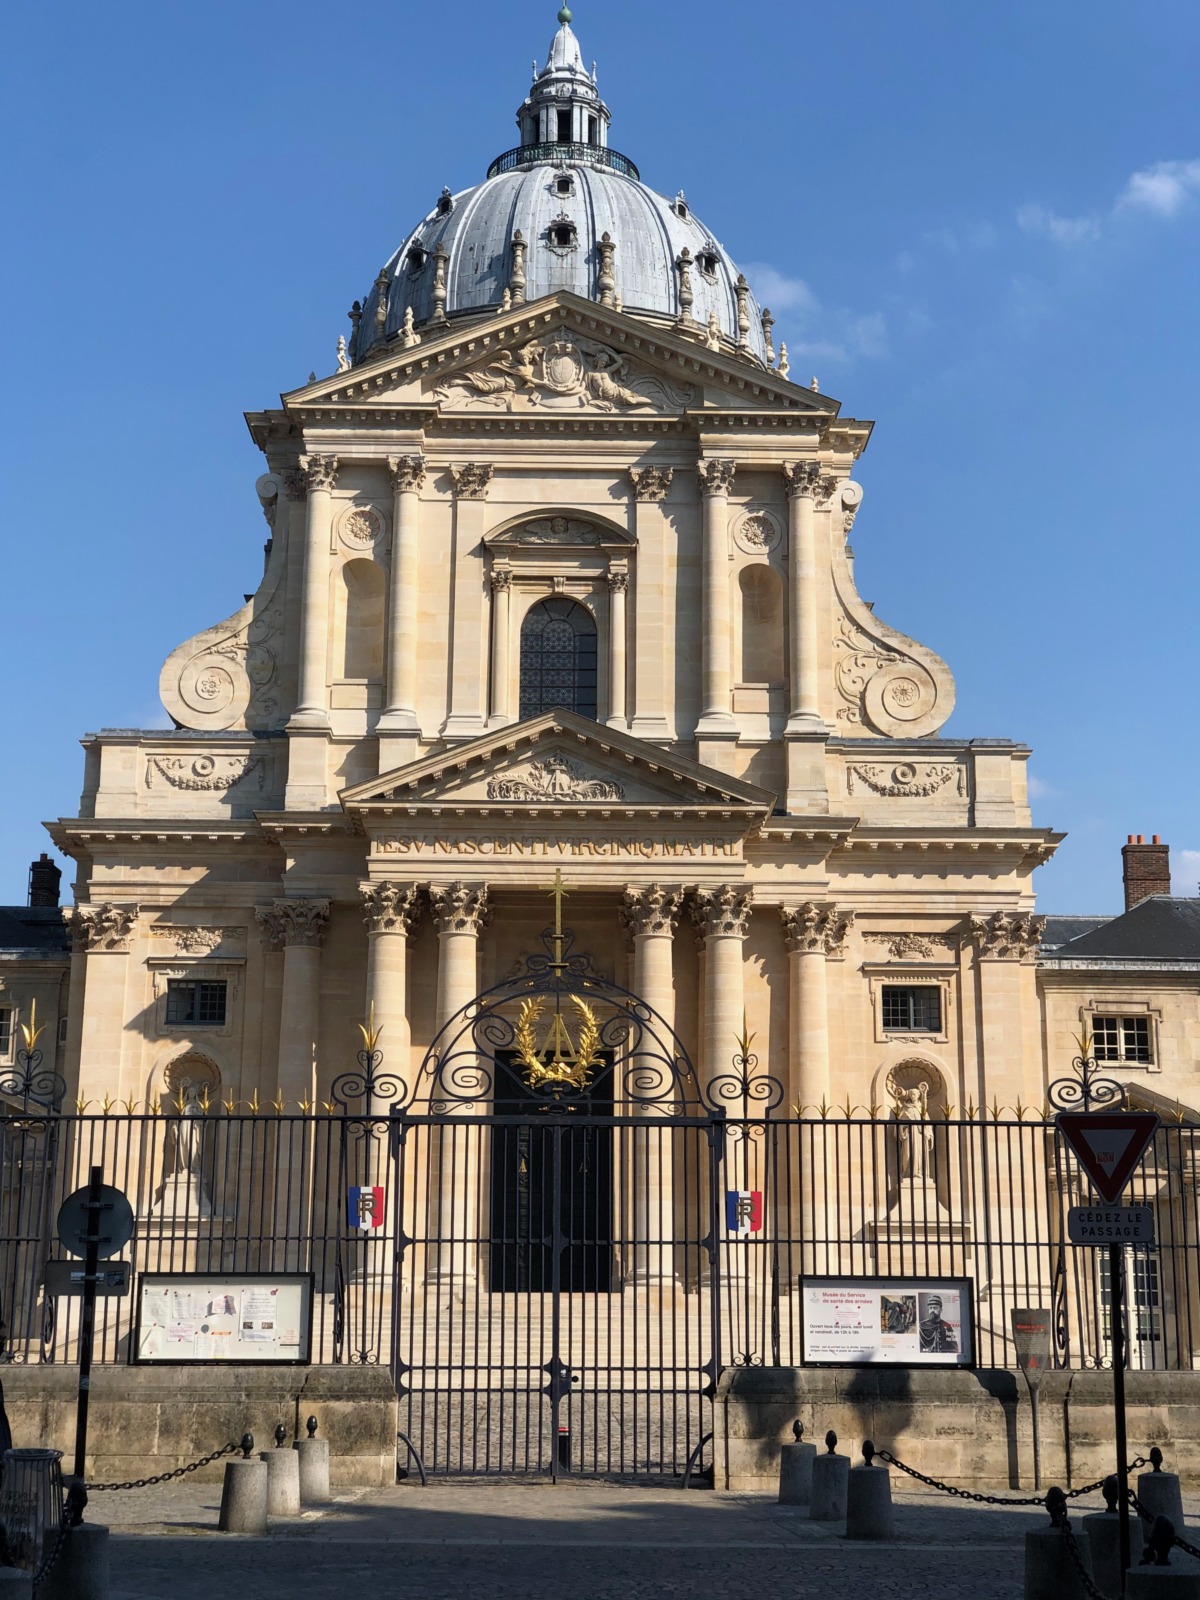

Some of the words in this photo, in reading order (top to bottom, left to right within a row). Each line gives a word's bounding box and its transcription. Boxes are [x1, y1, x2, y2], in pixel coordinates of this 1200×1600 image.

[375, 834, 426, 854] IESV
[432, 835, 549, 855] NASCENTI
[1078, 1211, 1121, 1223] CÉDEZ
[1127, 1213, 1142, 1223] LE
[1081, 1226, 1140, 1236] PASSAGE
